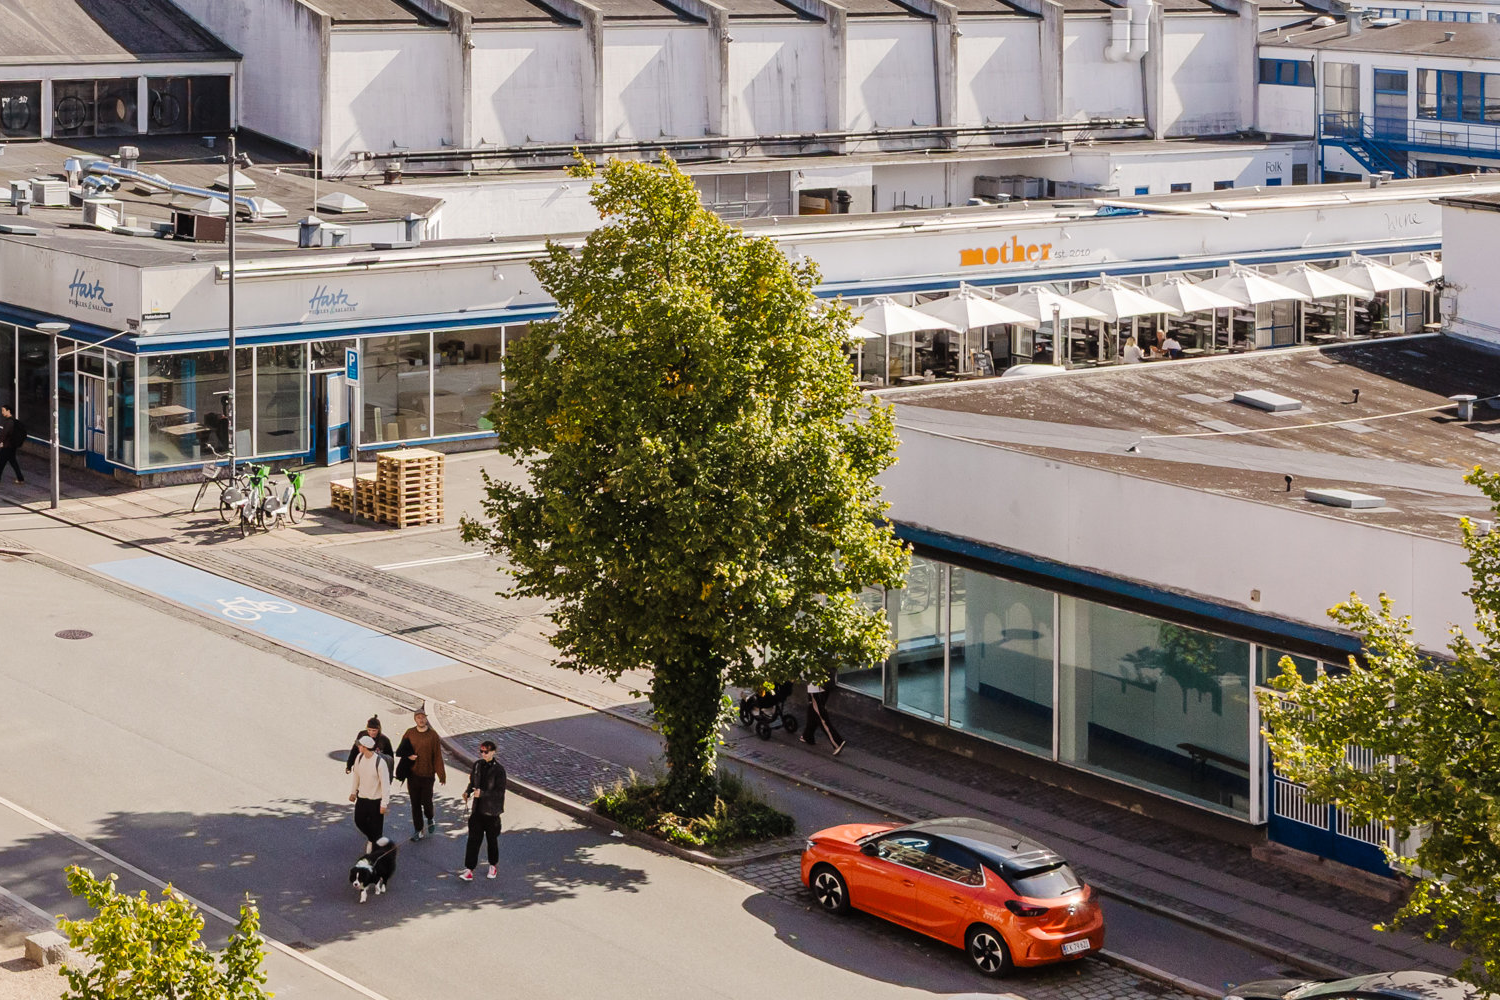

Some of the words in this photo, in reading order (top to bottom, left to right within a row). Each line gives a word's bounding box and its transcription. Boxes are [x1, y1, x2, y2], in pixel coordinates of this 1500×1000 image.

[959, 235, 1052, 266] mother
[1069, 249, 1090, 257] 2010
[69, 268, 113, 308] Hartz
[309, 285, 358, 315] Hartz
[349, 353, 356, 366] P
